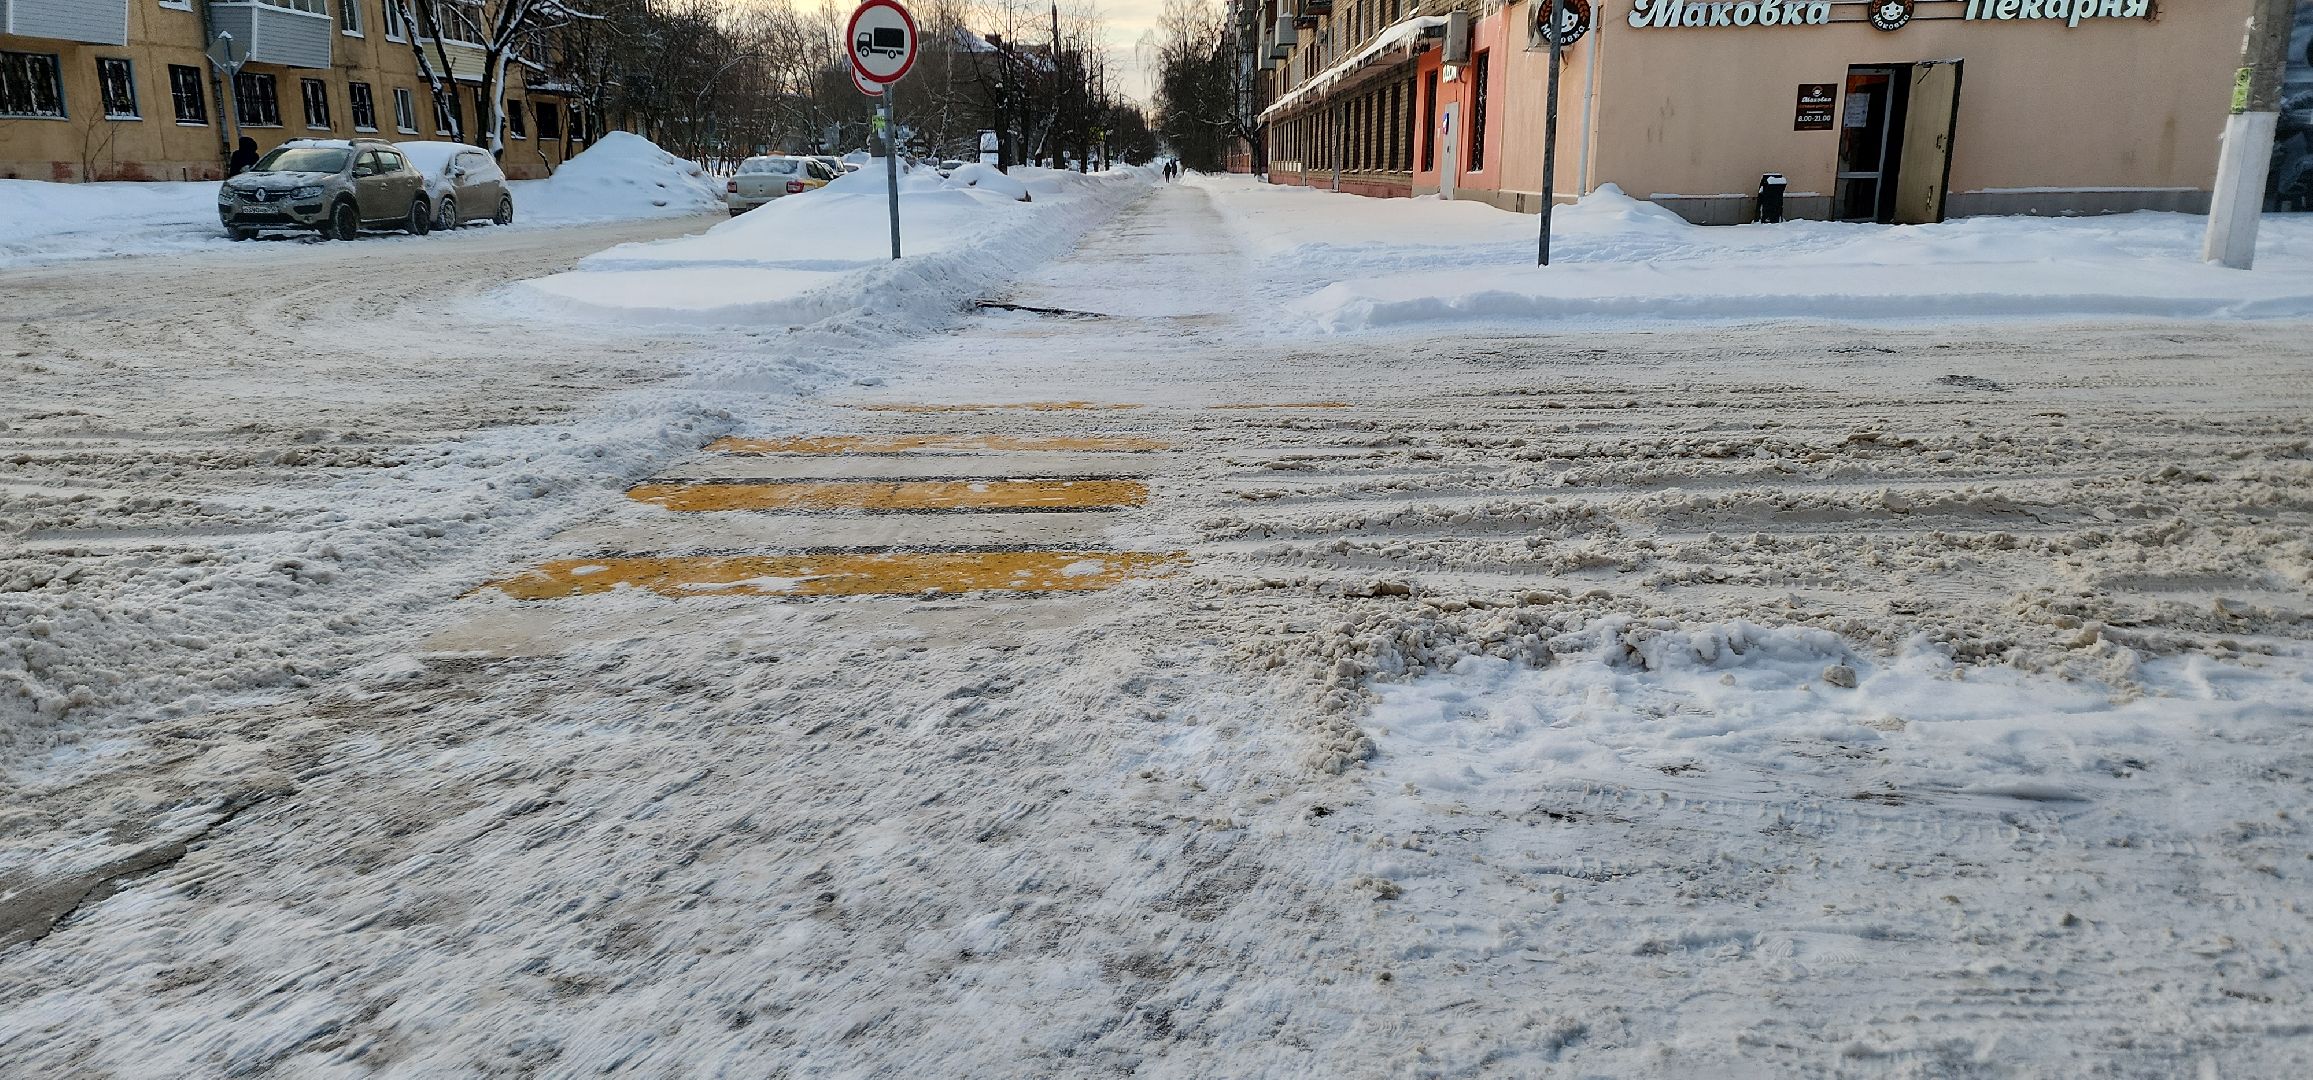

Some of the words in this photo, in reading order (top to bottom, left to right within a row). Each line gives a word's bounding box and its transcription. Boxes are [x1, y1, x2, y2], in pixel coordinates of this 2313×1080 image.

[1627, 0, 1832, 28] Маковка
[1873, 13, 1909, 29] Маковка
[1965, 0, 2149, 27] Пекарня
[1541, 23, 1585, 44] Маовка
